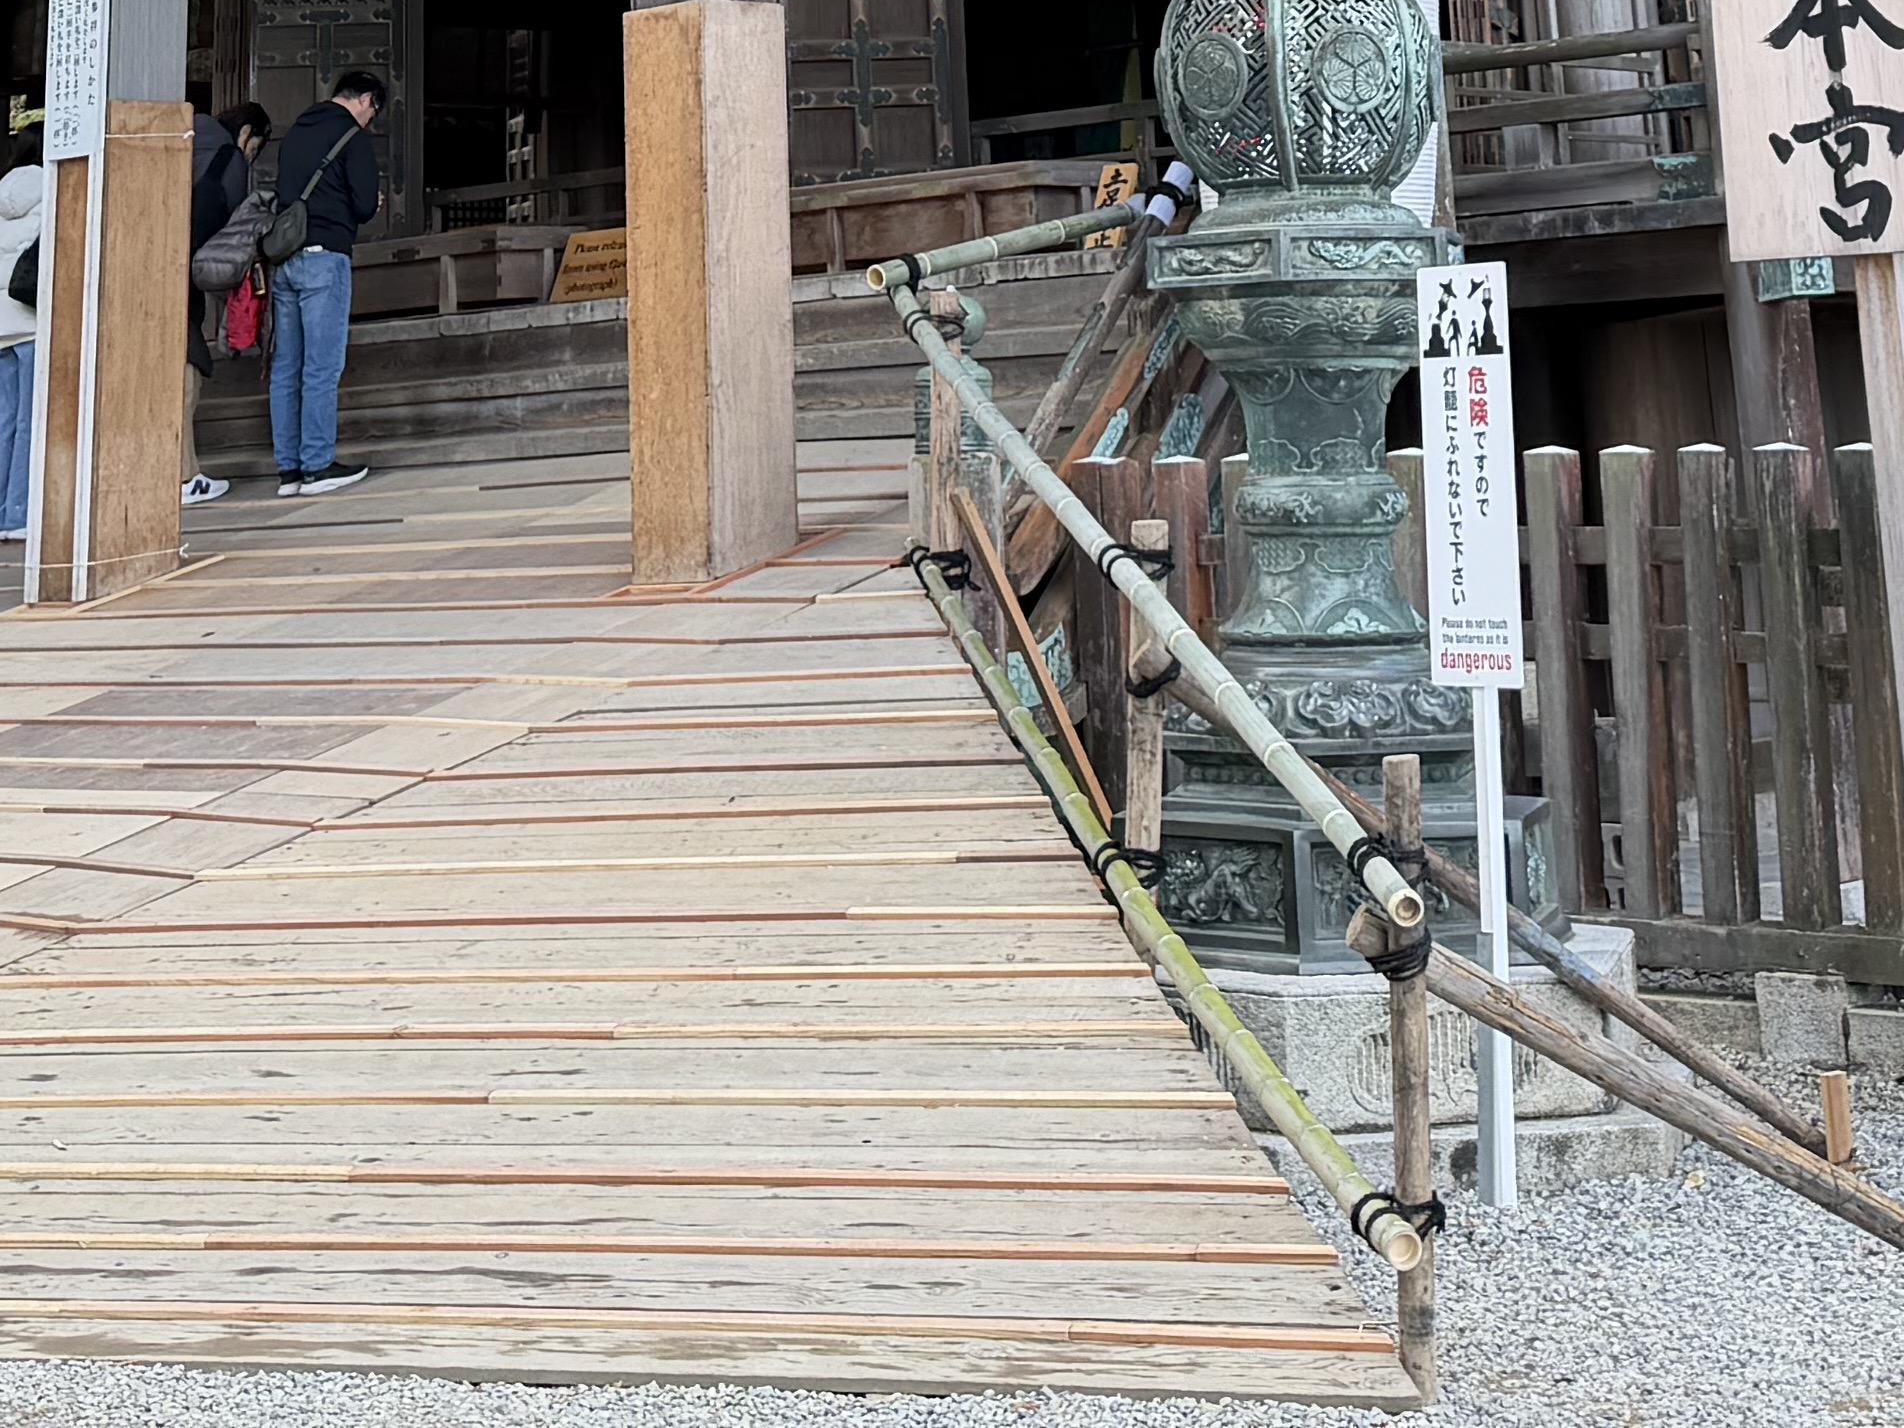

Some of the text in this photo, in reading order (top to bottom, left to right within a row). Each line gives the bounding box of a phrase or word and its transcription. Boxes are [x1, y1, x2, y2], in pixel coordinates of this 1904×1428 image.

[1094, 168, 1129, 248] 土足止
[1467, 366, 1489, 517] 危険ですので
[190, 479, 211, 495] N
[1441, 647, 1512, 674] dangerous
